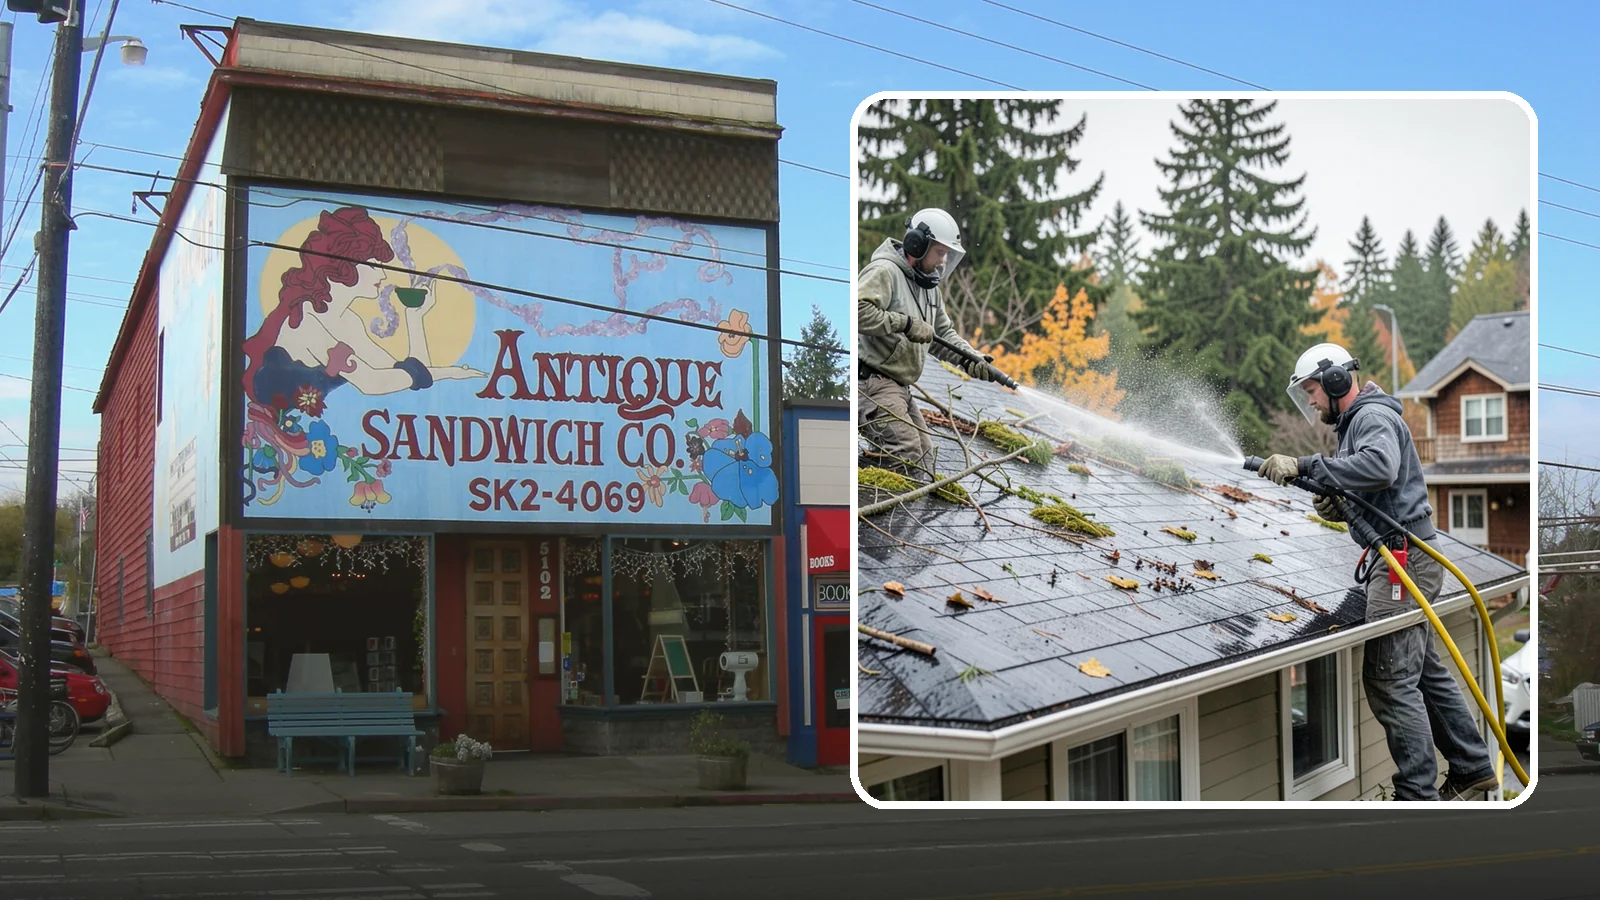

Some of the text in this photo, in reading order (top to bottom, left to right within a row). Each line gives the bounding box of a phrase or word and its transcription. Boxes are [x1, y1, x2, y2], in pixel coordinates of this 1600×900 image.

[475, 328, 724, 421] ANTIQUE
[361, 408, 685, 469] SANDWICH CO.
[468, 477, 646, 513] SK2-4069
[539, 542, 552, 600] 5102
[809, 555, 835, 569] BOOKS
